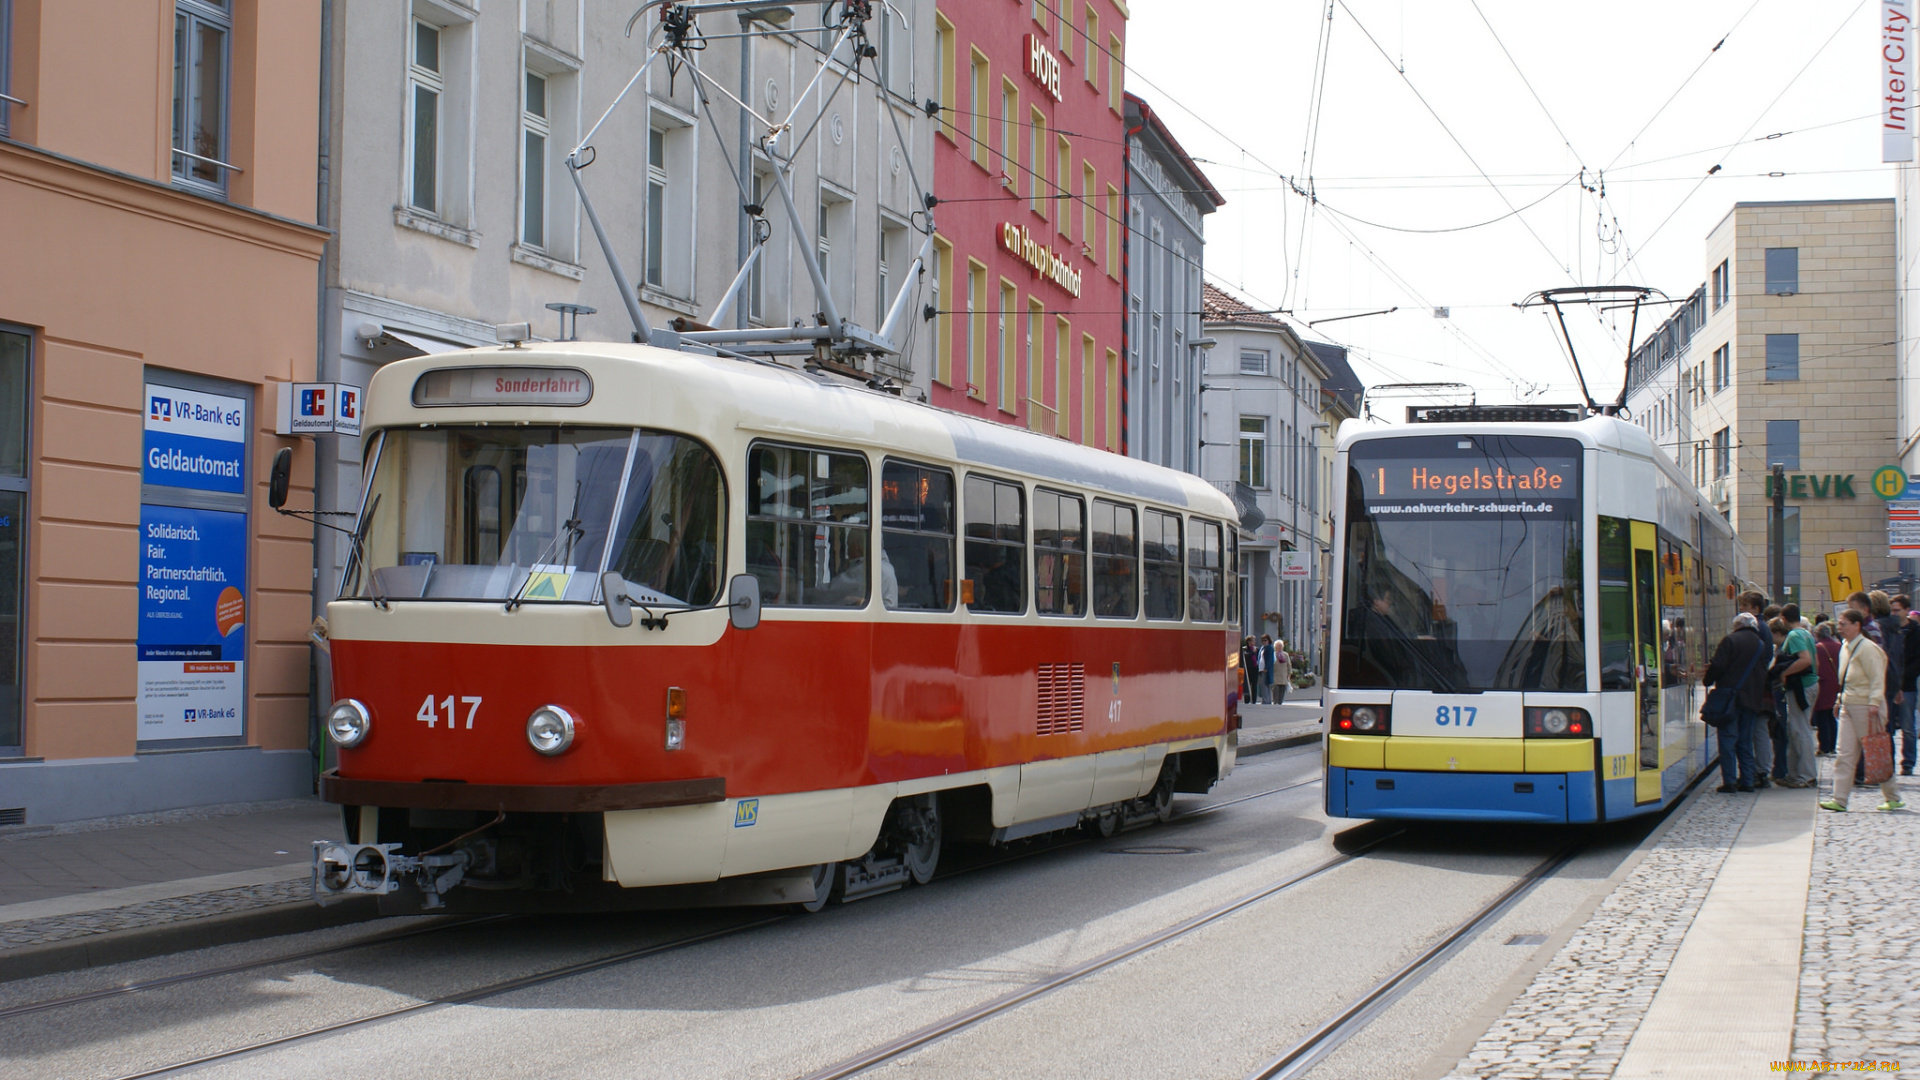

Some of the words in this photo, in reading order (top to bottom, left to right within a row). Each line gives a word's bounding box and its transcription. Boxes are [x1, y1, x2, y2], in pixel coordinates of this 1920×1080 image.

[1031, 33, 1063, 103] HOTEL
[1004, 221, 1020, 256] am
[1021, 224, 1082, 299] Hauptbahnhof
[495, 377, 581, 393] Sonderfahrt
[175, 400, 223, 424] VR-Bank
[225, 409, 241, 427] eG
[293, 419, 333, 428] Geldautomat
[148, 447, 240, 478] Geldautomat
[1412, 466, 1563, 496] Hegelstraße
[1882, 473, 1898, 492] H
[1369, 502, 1554, 514] www.nahverkehr-schwerin.de
[148, 523, 201, 541] Solidarisch.
[147, 544, 167, 559] Fair.
[1829, 558, 1837, 567] U
[147, 564, 227, 582] Partnerschaftlich.
[146, 585, 191, 604] Regional.
[197, 708, 225, 719] VR-Bank
[226, 708, 235, 718] eG
[416, 694, 483, 730] 417
[1108, 700, 1122, 724] 417
[1435, 705, 1478, 727] 817
[1612, 755, 1627, 777] 817
